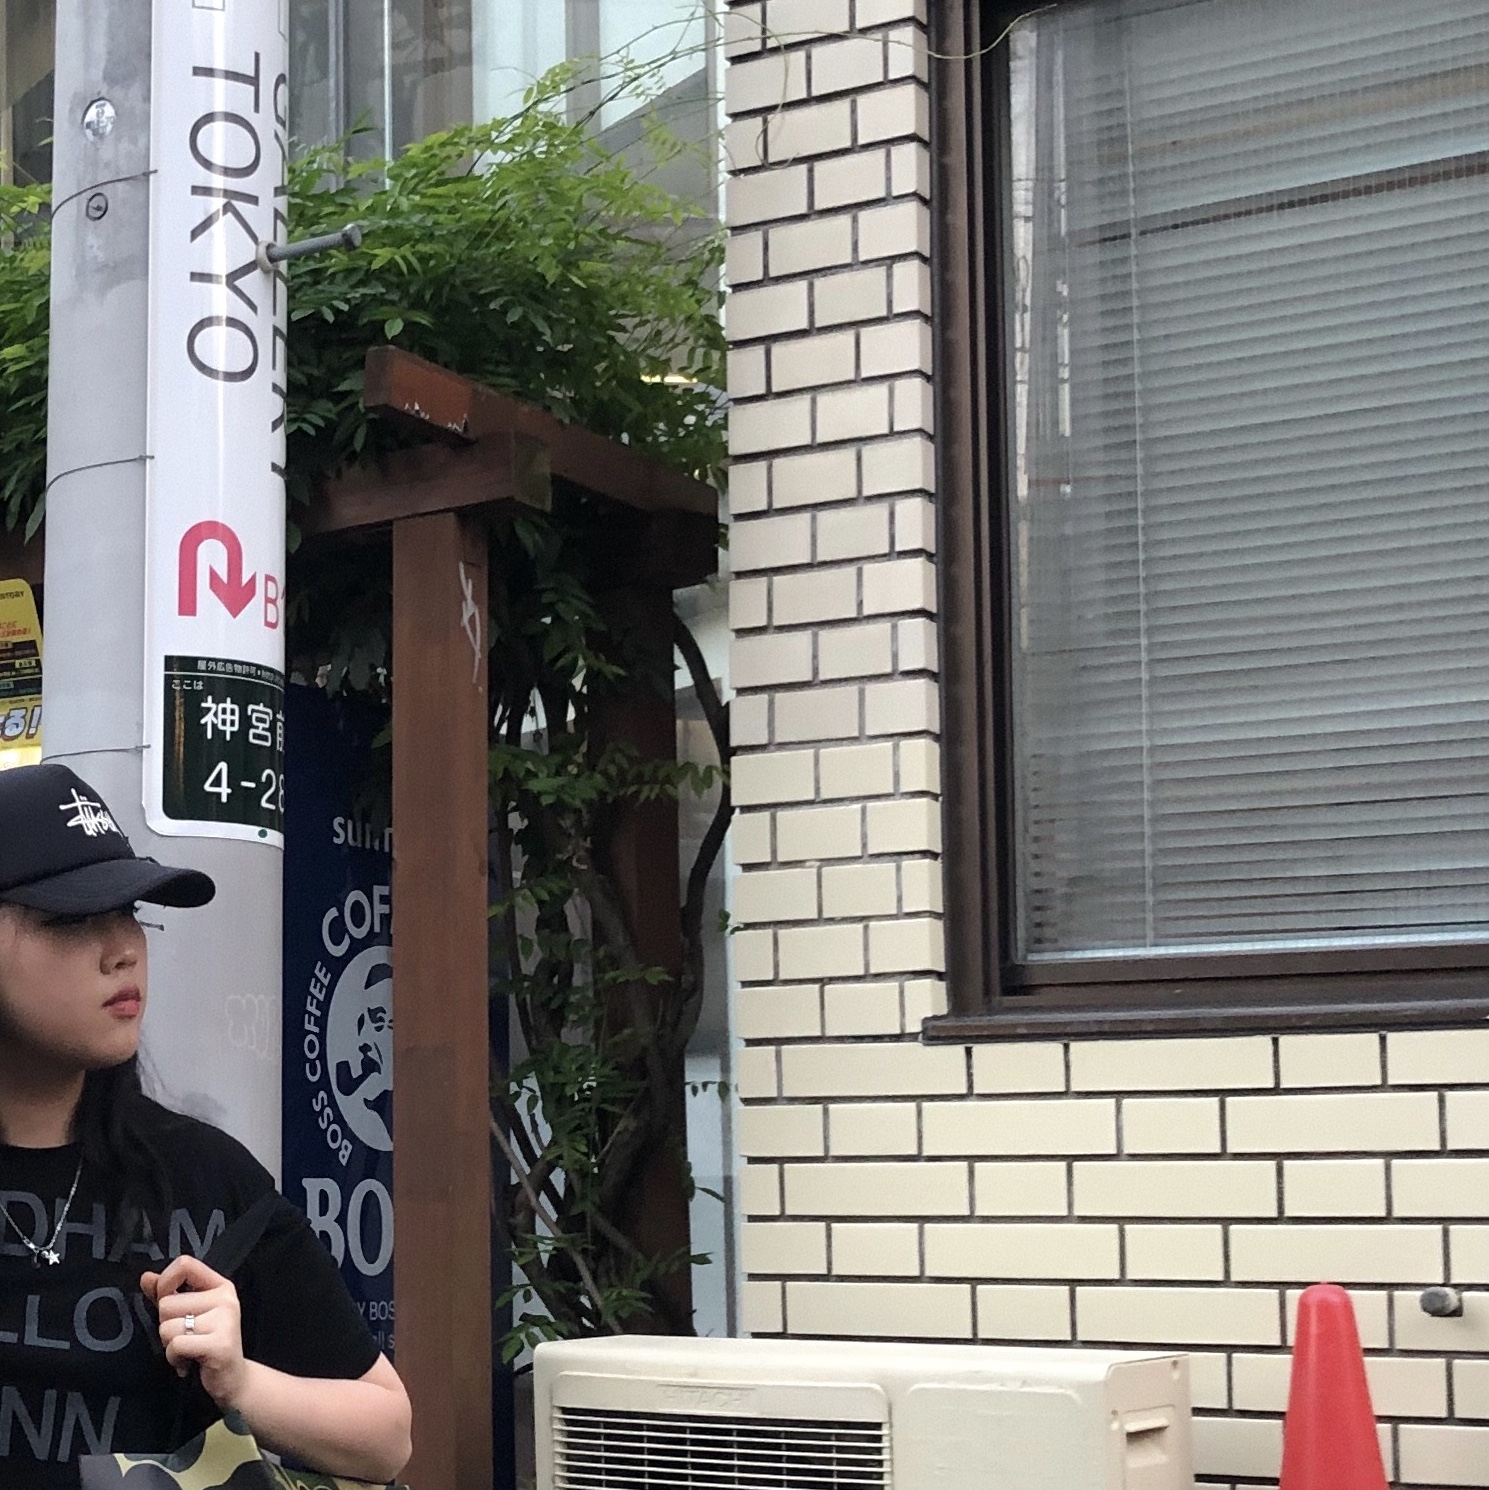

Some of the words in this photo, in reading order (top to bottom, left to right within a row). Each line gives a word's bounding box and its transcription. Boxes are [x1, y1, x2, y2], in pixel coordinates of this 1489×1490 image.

[186, 51, 261, 383] TOKYO
[171, 679, 204, 691] ここは
[322, 885, 392, 957] COF
[303, 961, 332, 1082] COFFEE
[313, 1090, 353, 1167] BOSS
